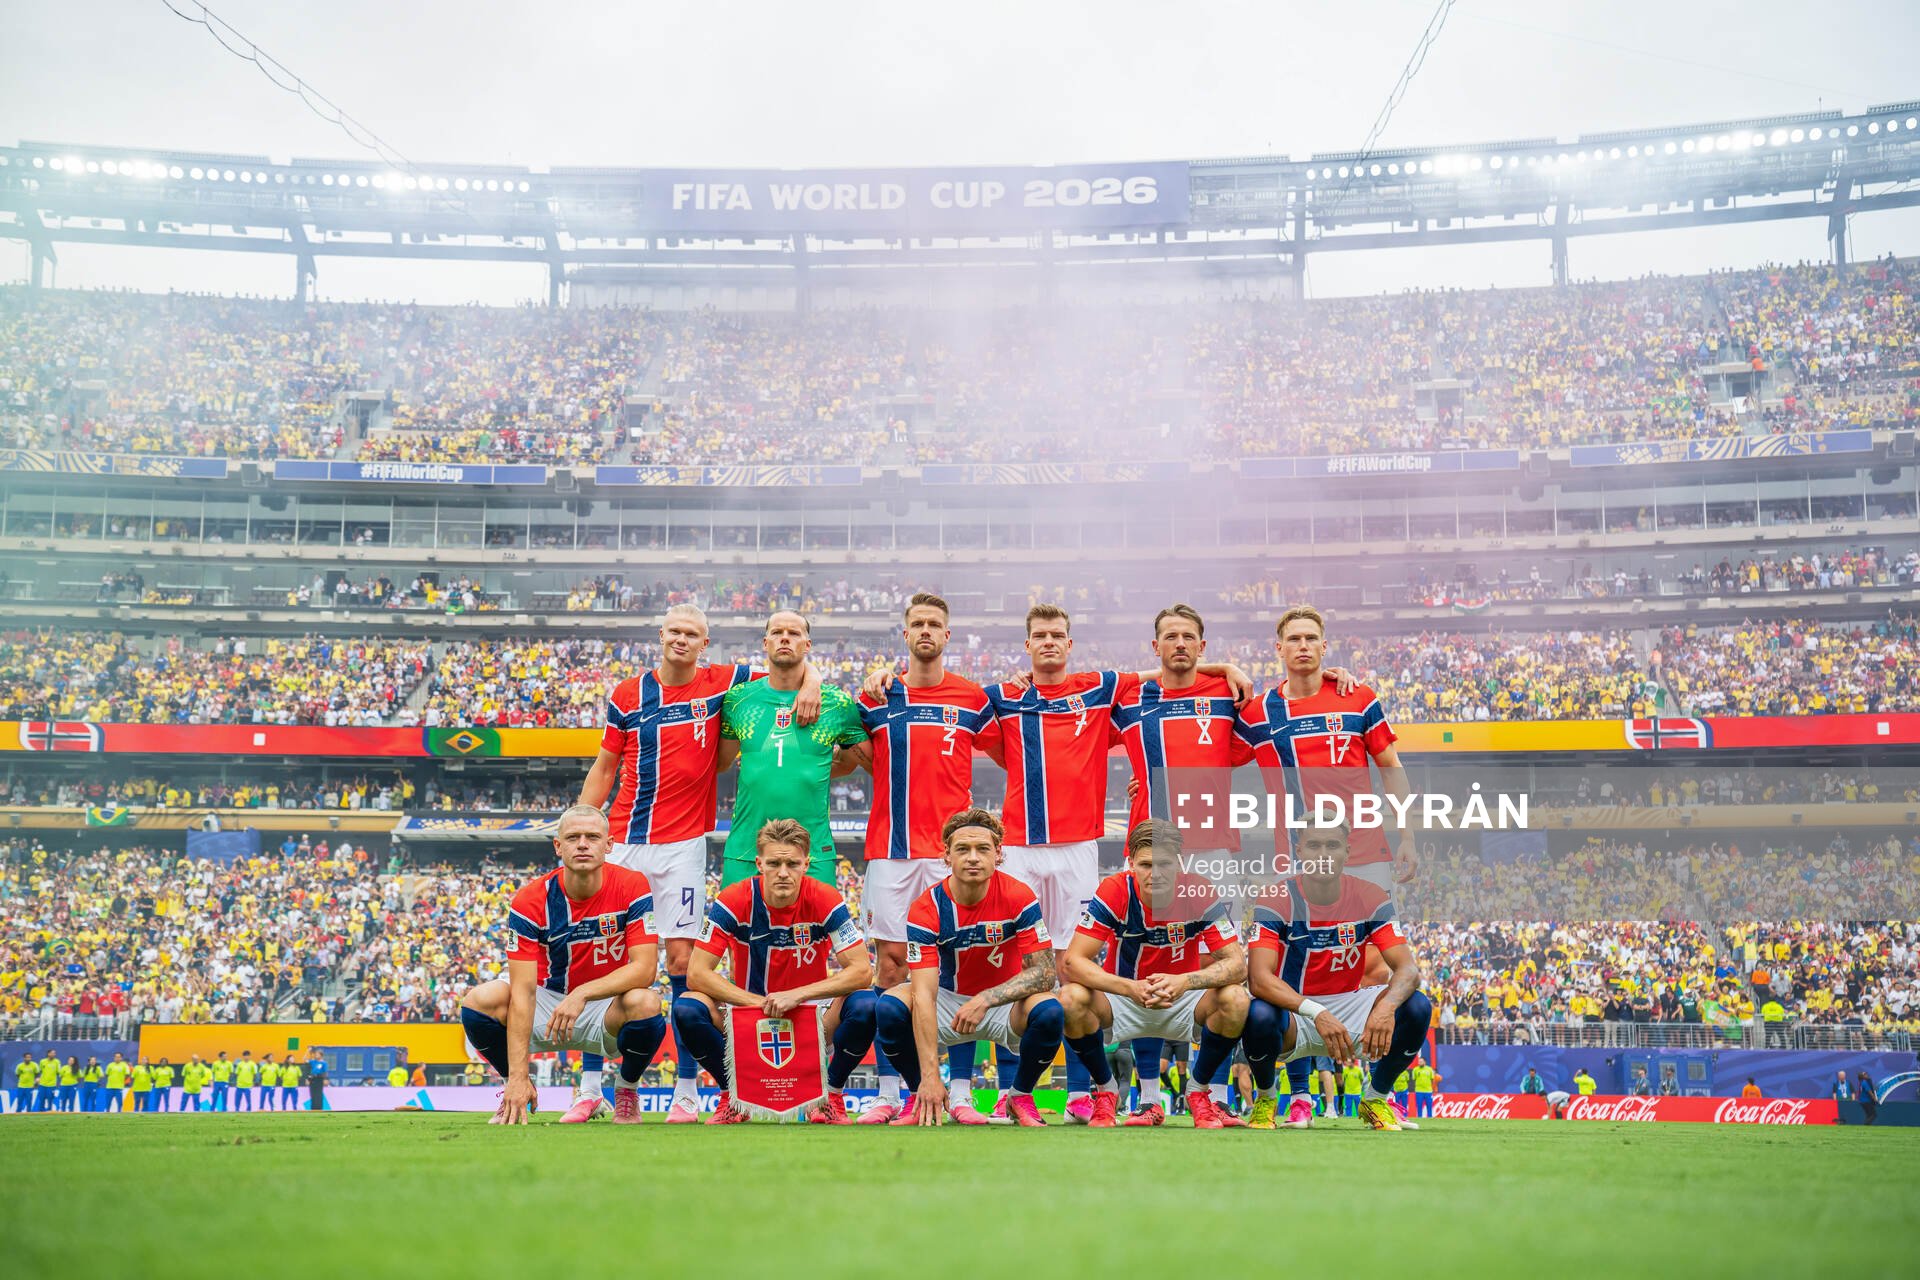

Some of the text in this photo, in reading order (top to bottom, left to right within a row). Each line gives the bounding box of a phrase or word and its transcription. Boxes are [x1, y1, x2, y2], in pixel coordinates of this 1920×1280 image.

[672, 176, 1158, 211] FIFA WORLD CUP 2026
[360, 463, 464, 482] #FIFAWorldCup
[1327, 455, 1432, 473] #FIFAWorldCup
[694, 720, 706, 748] 9
[1074, 711, 1087, 737] 7
[1196, 718, 1213, 745] 8
[774, 738, 784, 767] 1
[941, 727, 957, 756] 3
[1325, 735, 1352, 765] 17
[681, 887, 695, 916] 9
[592, 934, 626, 966] 26
[792, 946, 817, 969] 10
[986, 945, 1004, 968] 6
[1329, 946, 1361, 972] 20
[638, 1095, 673, 1112] FIF
[1566, 1095, 1662, 1122] Coca-Cola
[1714, 1097, 1811, 1125] Coca-Cola
